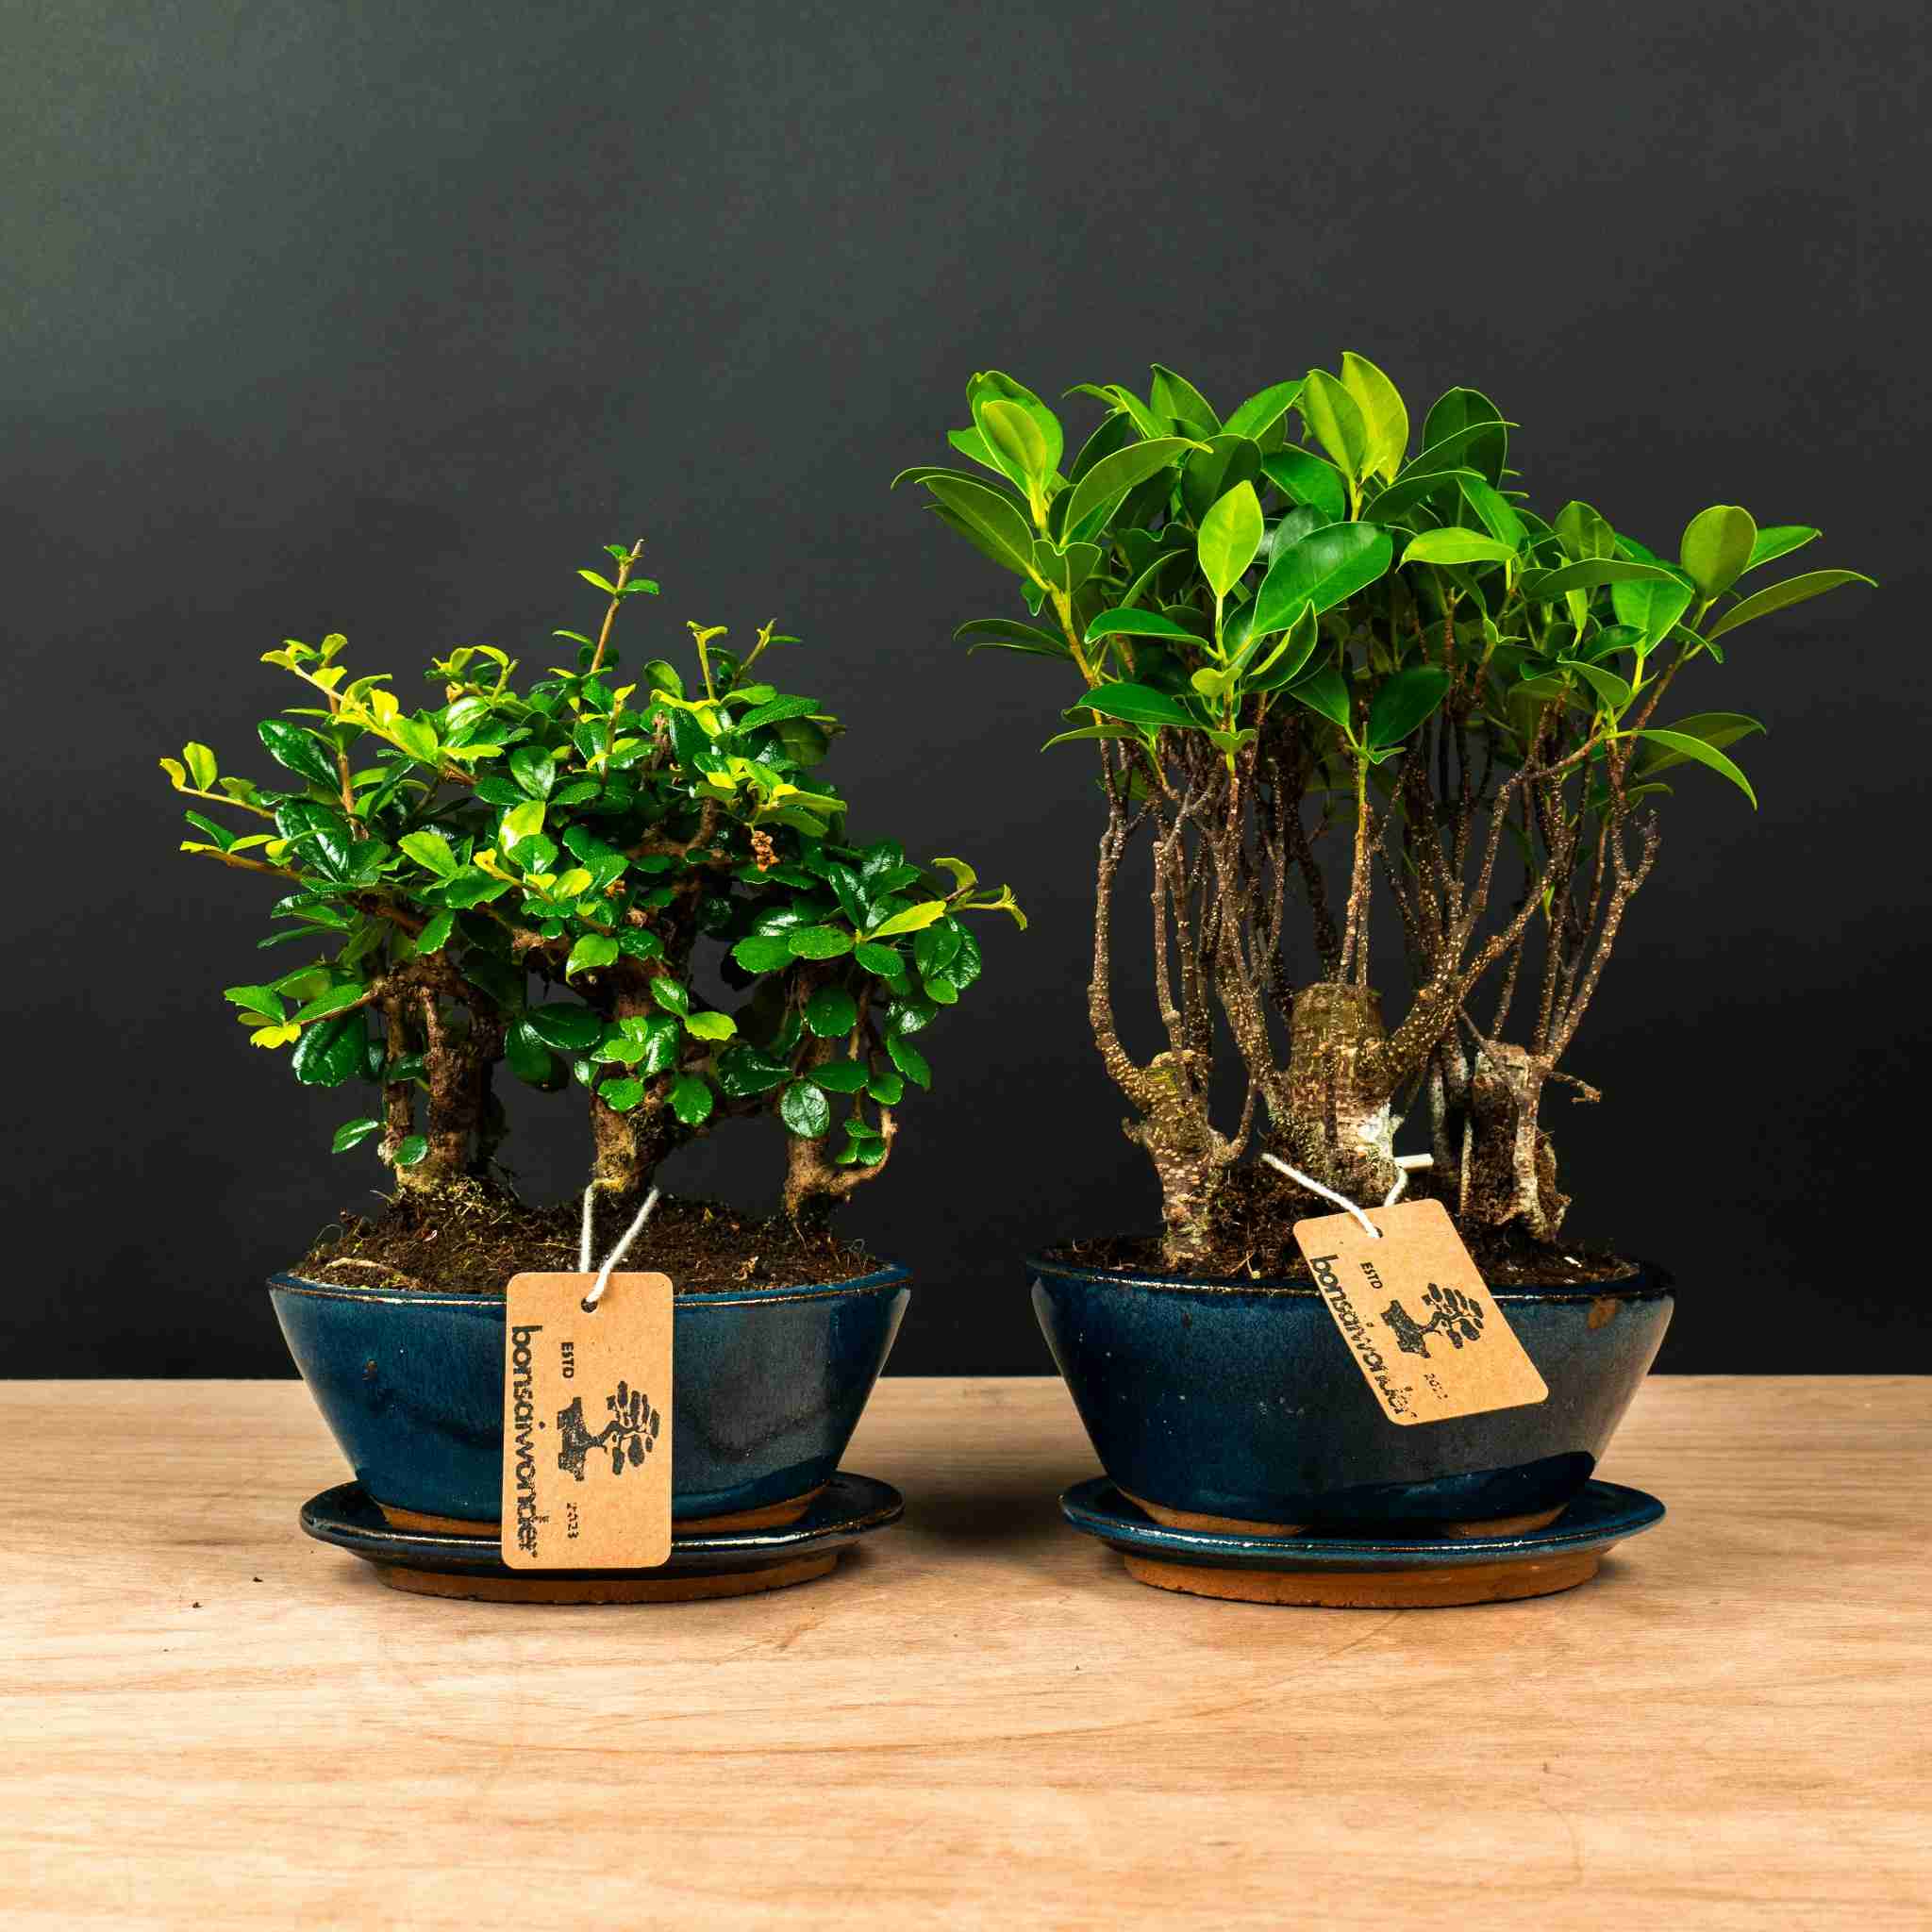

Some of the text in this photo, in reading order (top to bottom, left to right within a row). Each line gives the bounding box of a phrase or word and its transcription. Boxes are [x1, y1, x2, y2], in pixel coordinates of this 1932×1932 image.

[1358, 1261, 1383, 1290] ESTD
[560, 1341, 575, 1379] ESTD
[511, 1324, 549, 1557] bonsaiwonder
